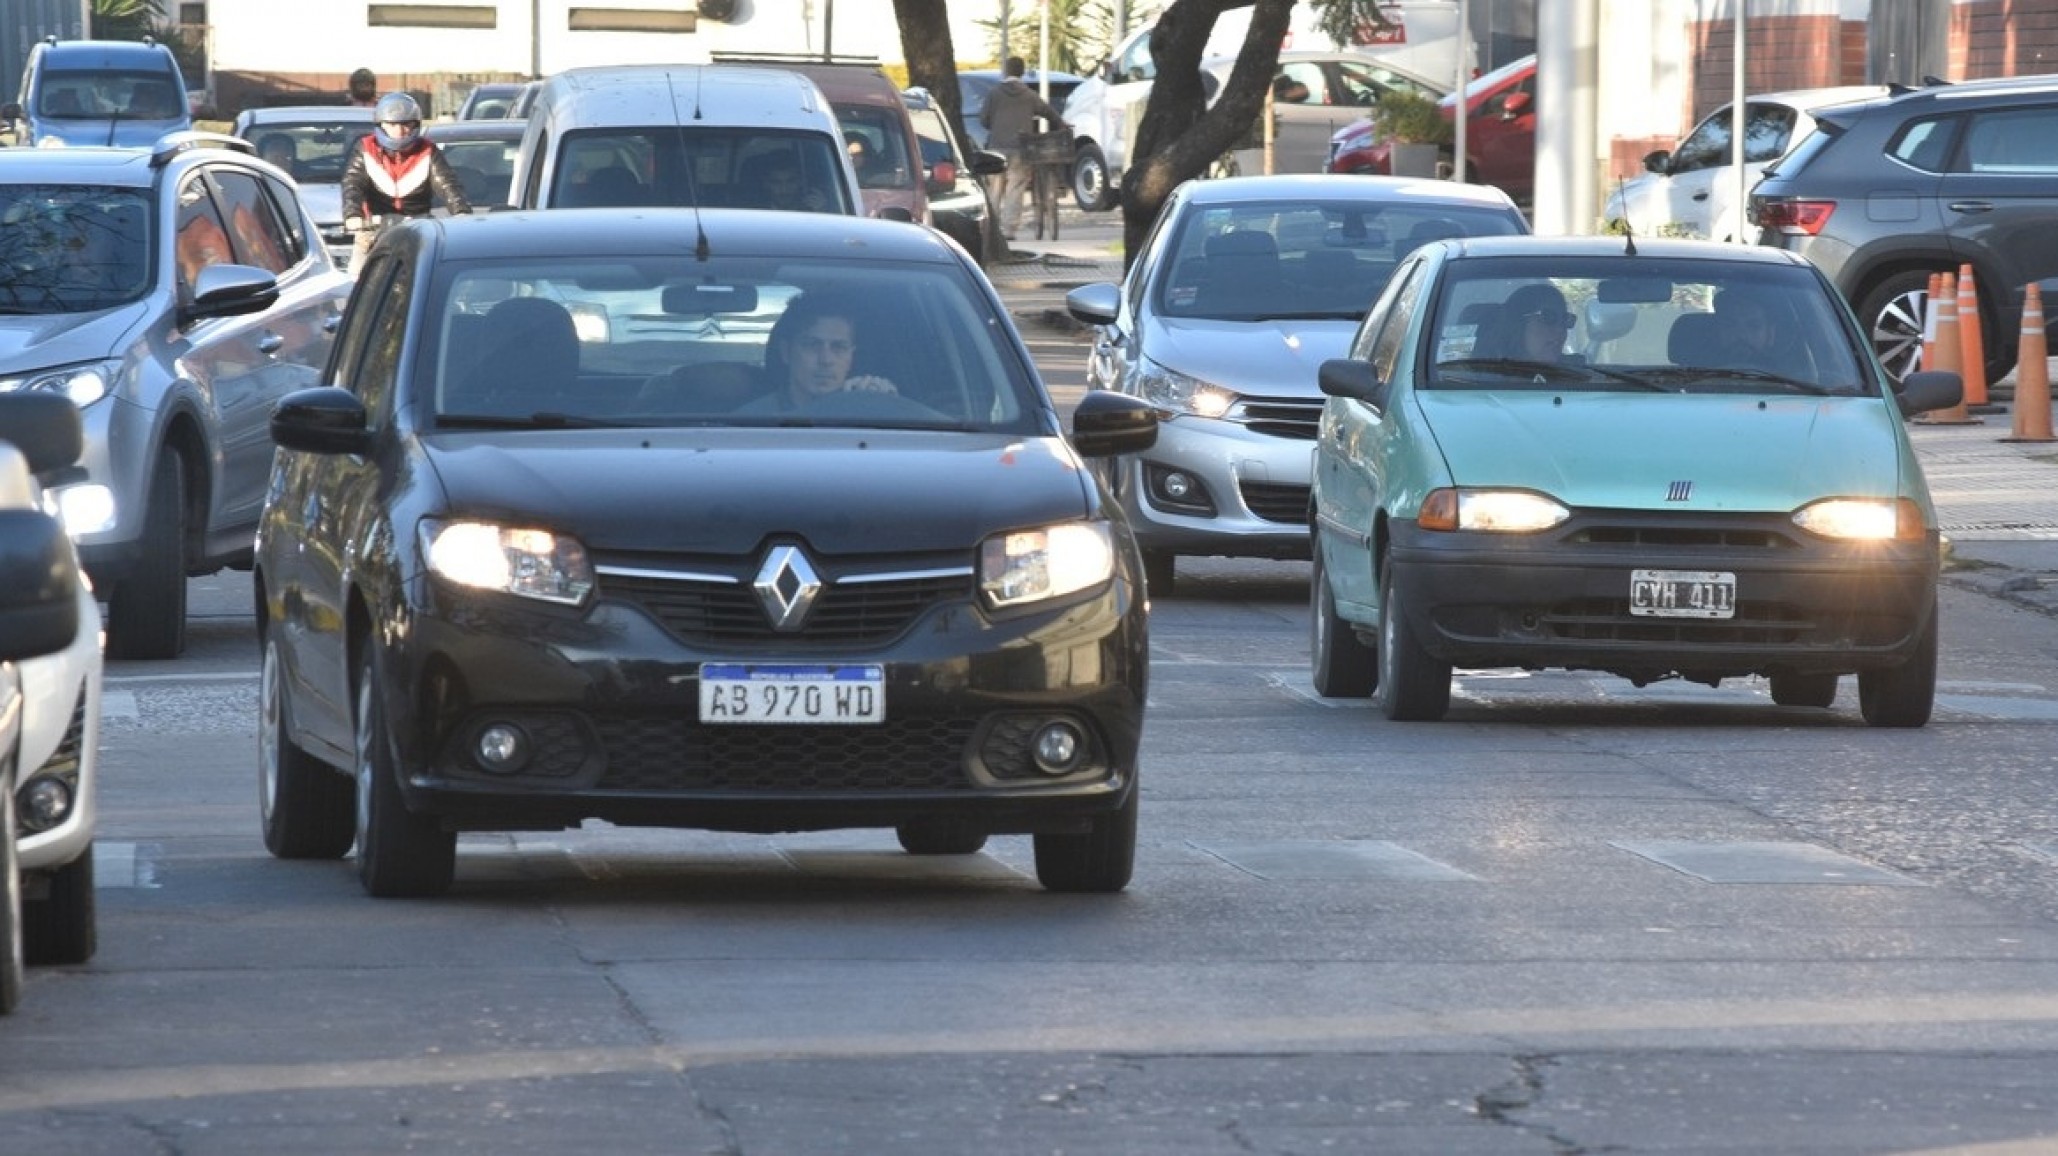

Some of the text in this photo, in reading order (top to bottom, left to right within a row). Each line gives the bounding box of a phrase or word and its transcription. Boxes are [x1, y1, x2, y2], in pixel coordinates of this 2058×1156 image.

[1636, 582, 1729, 610] CYH 411
[711, 685, 873, 716] AB 970 WD
